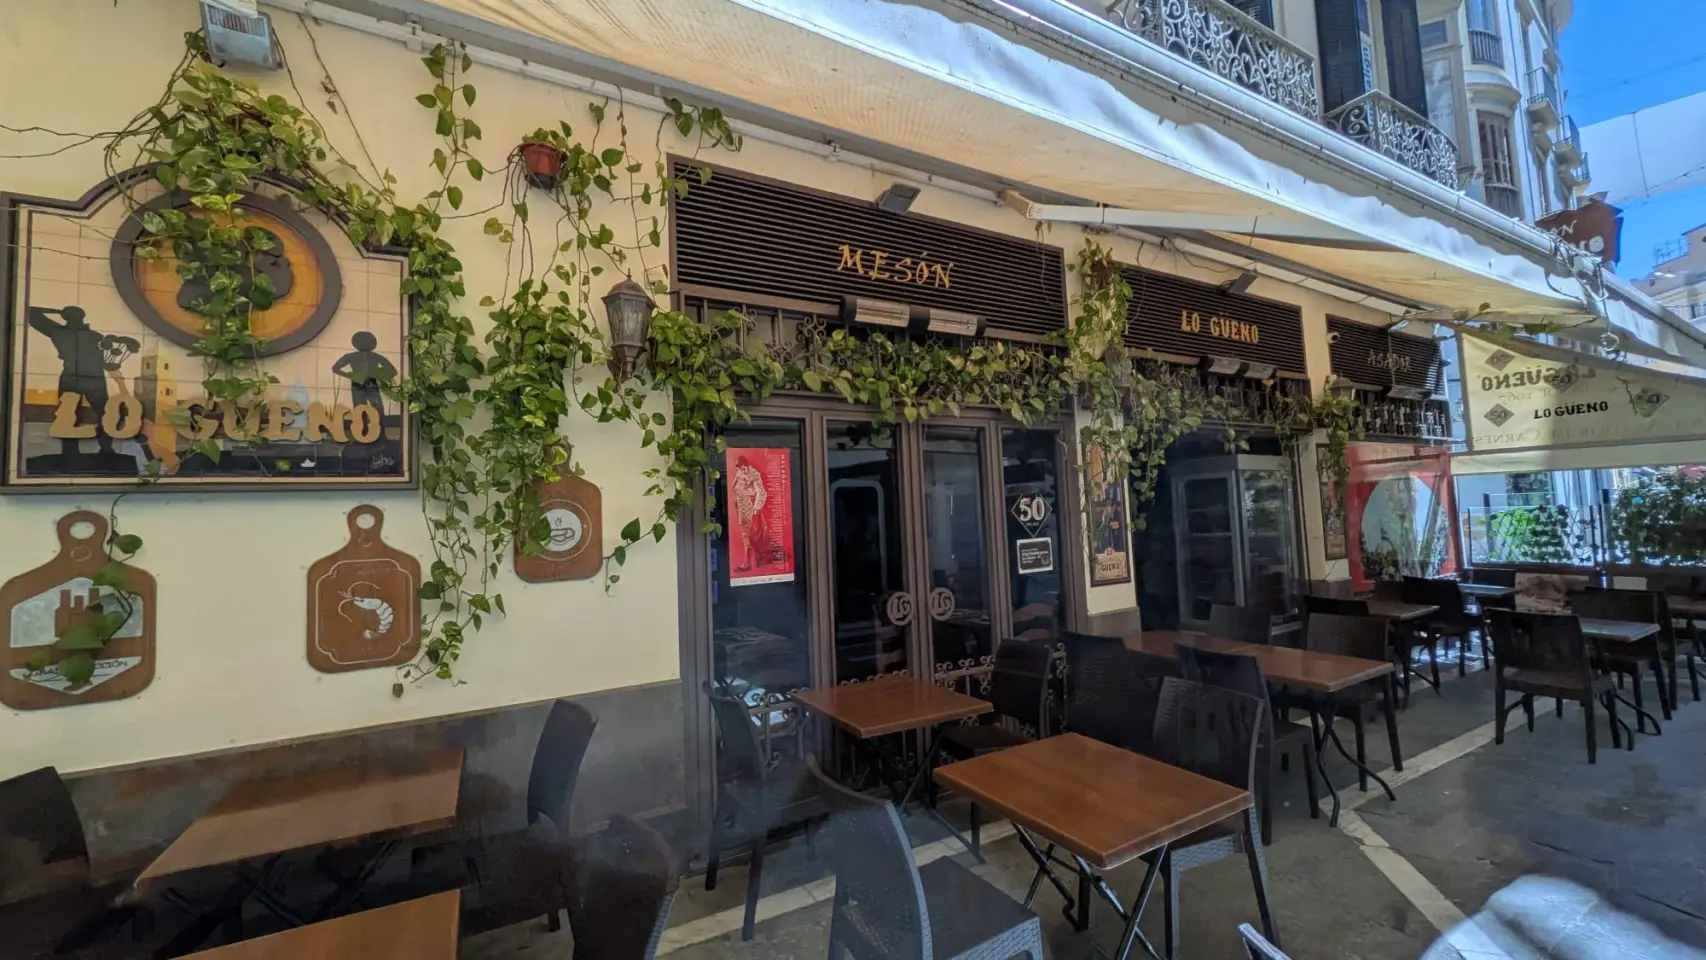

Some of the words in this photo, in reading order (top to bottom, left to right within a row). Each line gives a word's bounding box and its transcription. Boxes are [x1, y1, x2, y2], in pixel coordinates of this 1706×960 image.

[837, 244, 954, 289] MESÓN
[1181, 309, 1200, 333] LO
[1210, 311, 1259, 344] GÜENO
[1367, 349, 1411, 372] ASADOR
[50, 391, 145, 439] LO
[1533, 408, 1552, 420] LO
[1554, 400, 1609, 417] GÜENO
[1019, 496, 1045, 521] 50
